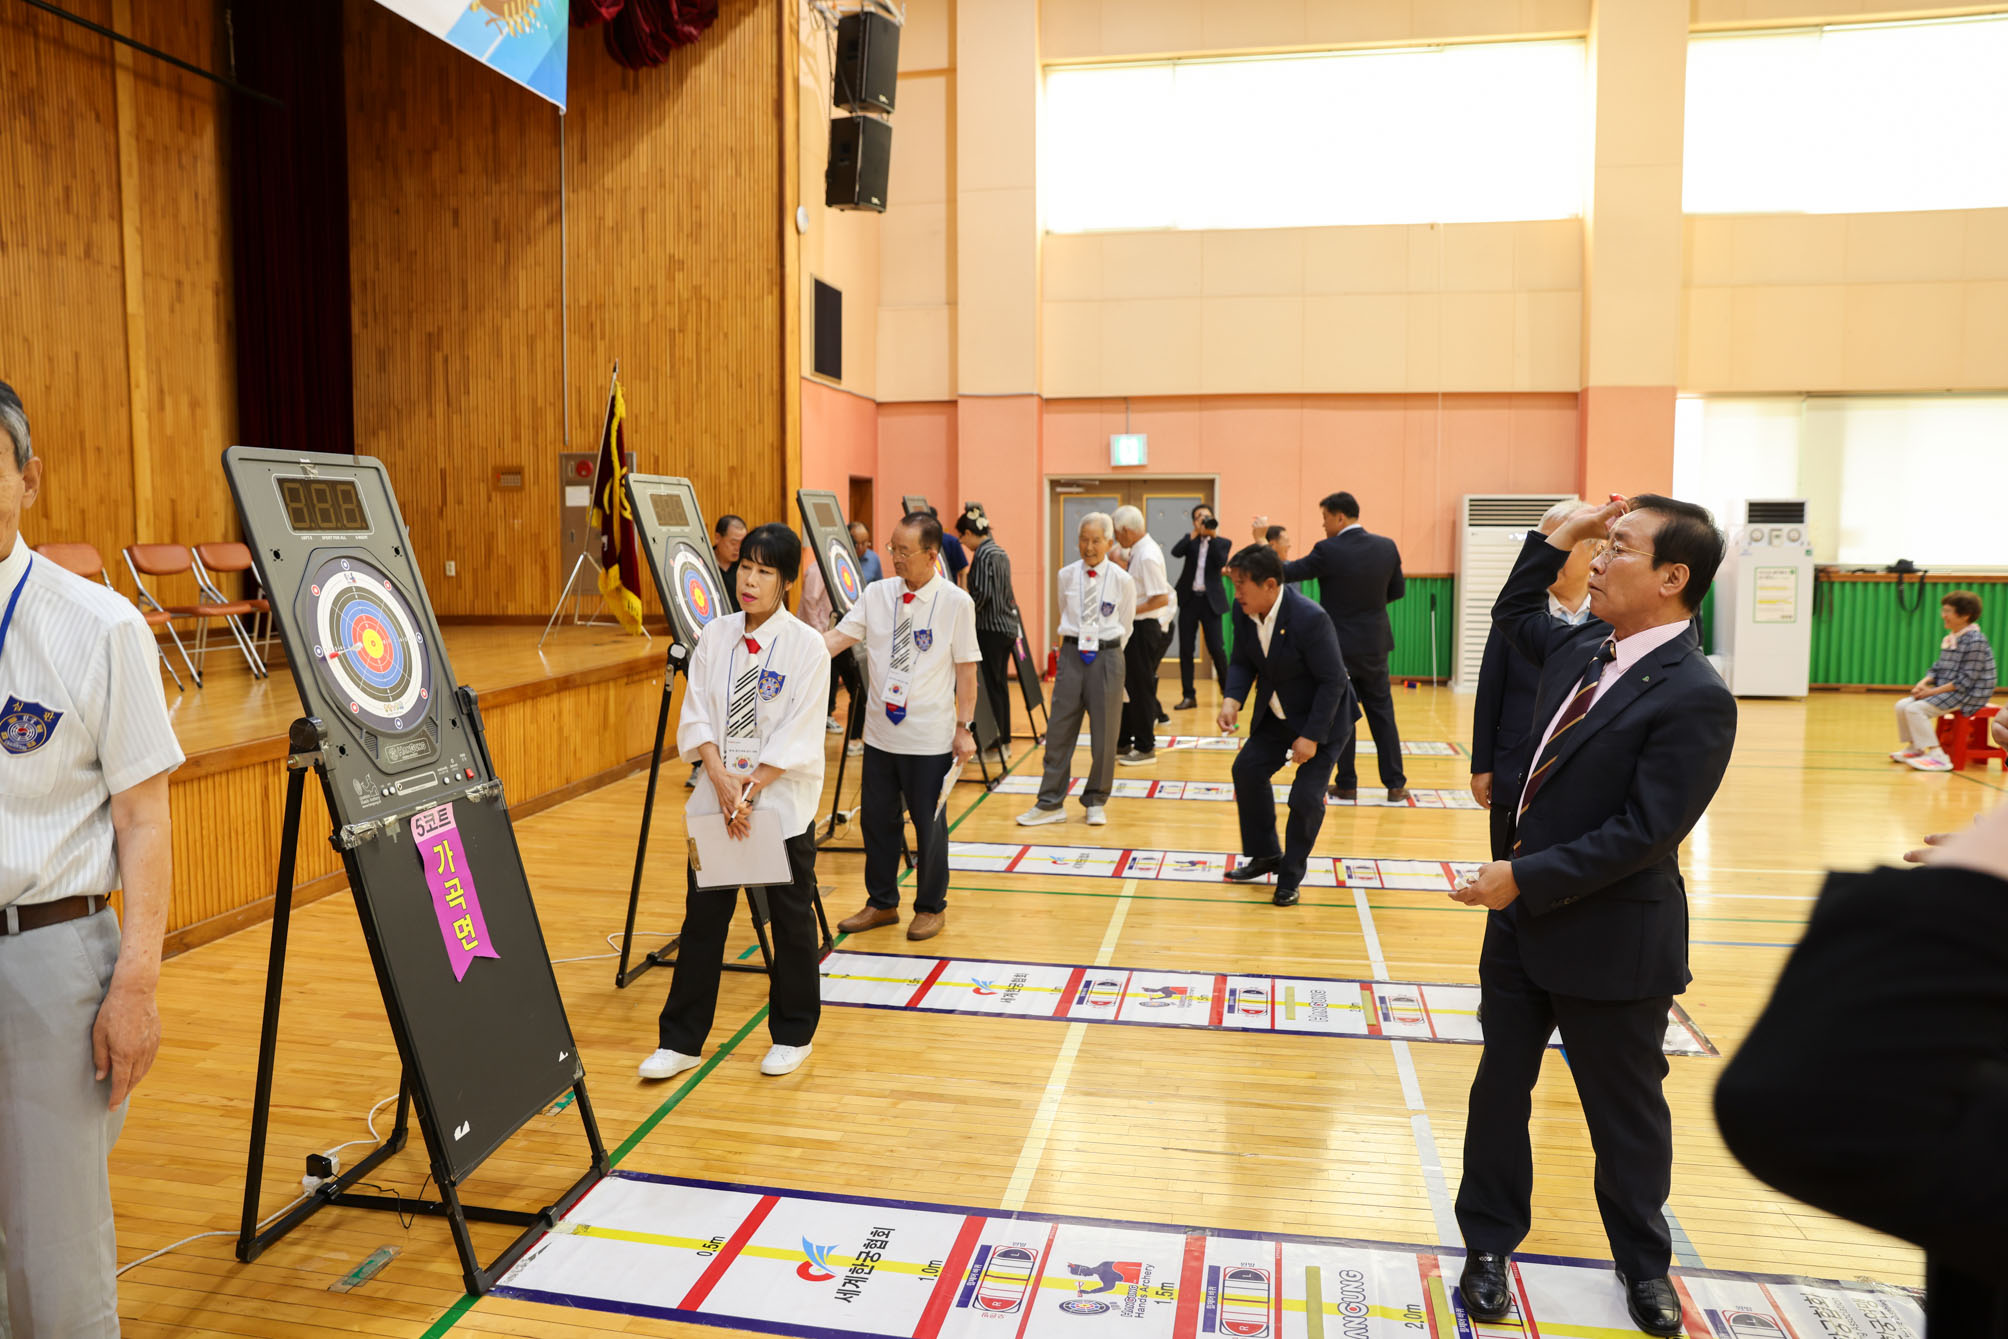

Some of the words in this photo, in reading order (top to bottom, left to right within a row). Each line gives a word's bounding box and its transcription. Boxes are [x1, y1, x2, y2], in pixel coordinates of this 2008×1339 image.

[415, 807, 451, 837] 5코트
[432, 839, 479, 951] 가곡면
[696, 1235, 726, 1258] 0.5m
[834, 1226, 896, 1304] 세계한궁협회
[918, 1260, 943, 1281] 1.0m
[1140, 1263, 1155, 1292] Archery
[1134, 1292, 1148, 1319] Hands
[1154, 1281, 1175, 1306] 1.5m
[1403, 1304, 1424, 1330] 2.0m
